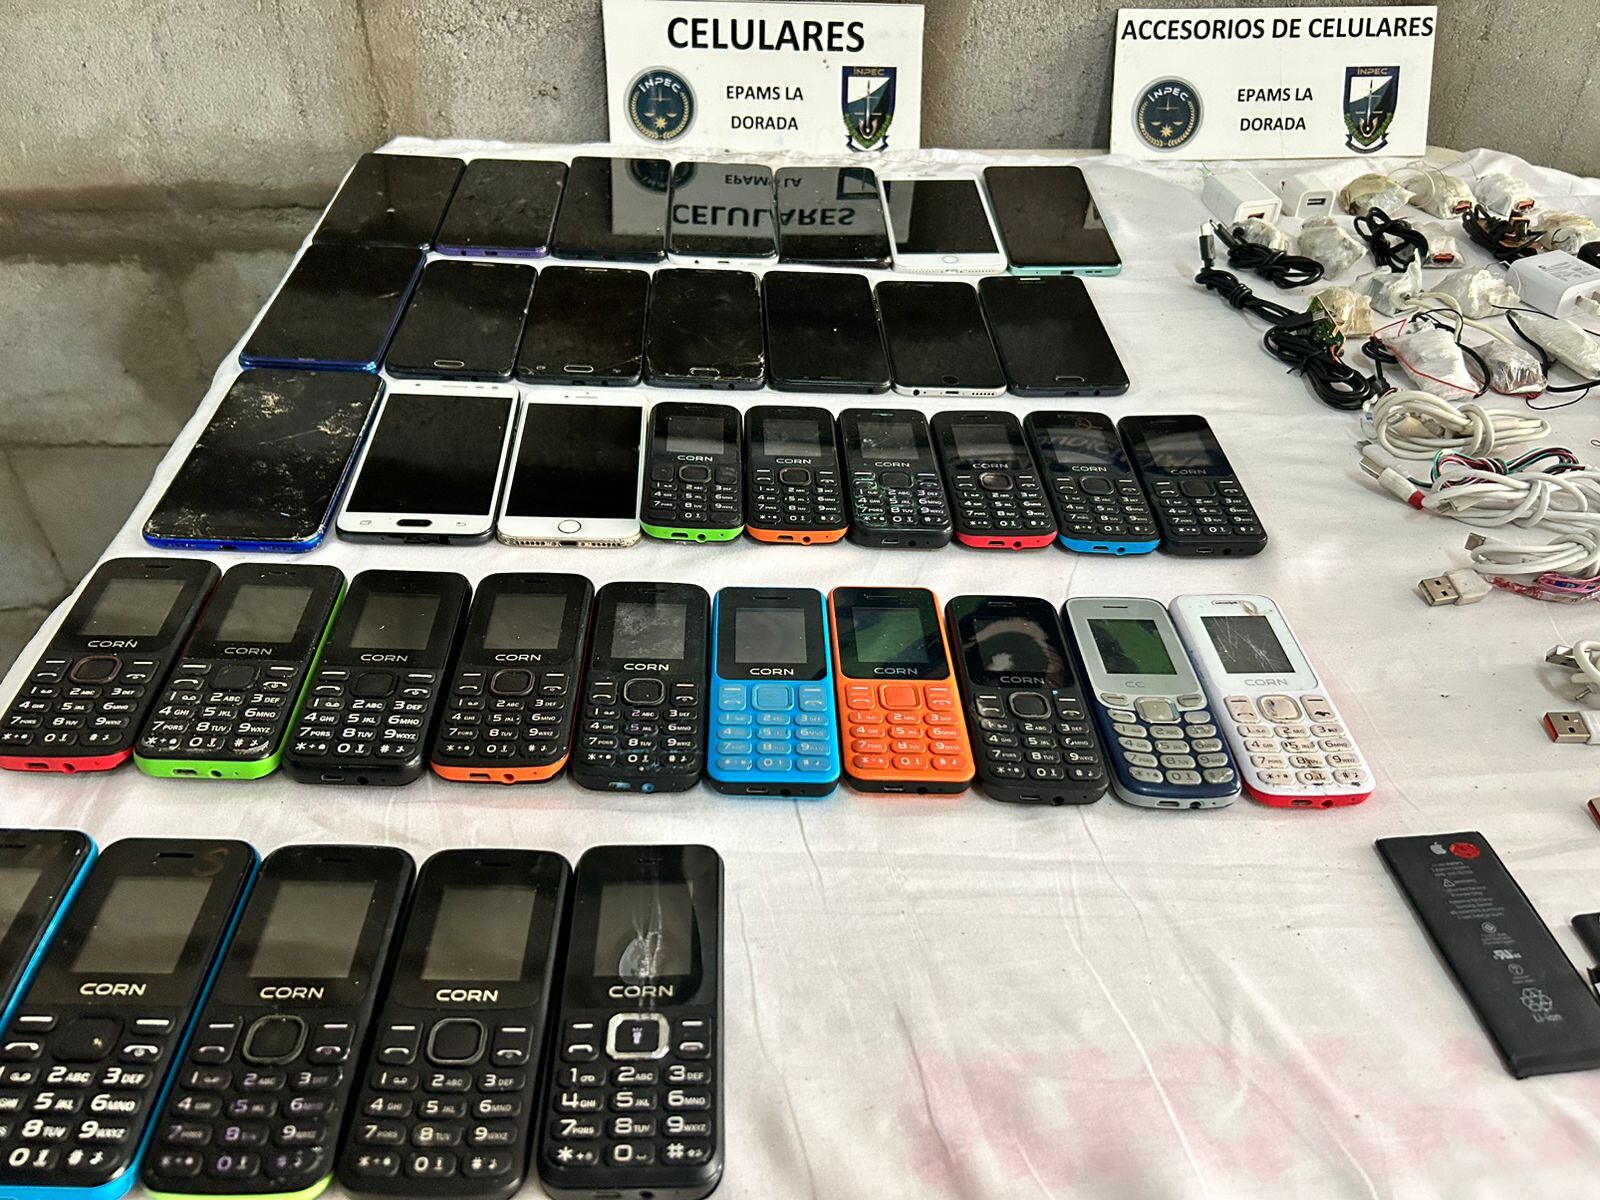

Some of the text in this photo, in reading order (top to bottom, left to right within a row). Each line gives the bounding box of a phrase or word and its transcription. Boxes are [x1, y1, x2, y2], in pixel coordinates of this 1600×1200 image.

[667, 17, 865, 53] CELULARES
[1122, 17, 1434, 40] ACCESORIOS DE CELULARES
[854, 67, 885, 76] INPEC
[639, 78, 680, 93] INPEC
[726, 86, 804, 100] EPAMS LA
[1148, 87, 1188, 102] INPEC
[1237, 88, 1313, 102] EPAMS LA
[731, 116, 798, 130] DORADA
[1240, 118, 1306, 131] DORADA
[88, 639, 138, 648] CORN
[360, 654, 408, 662] CORN
[80, 983, 146, 996] CORN
[260, 987, 324, 998] CORN
[436, 989, 498, 1001] CORN
[609, 986, 673, 998] CORN
